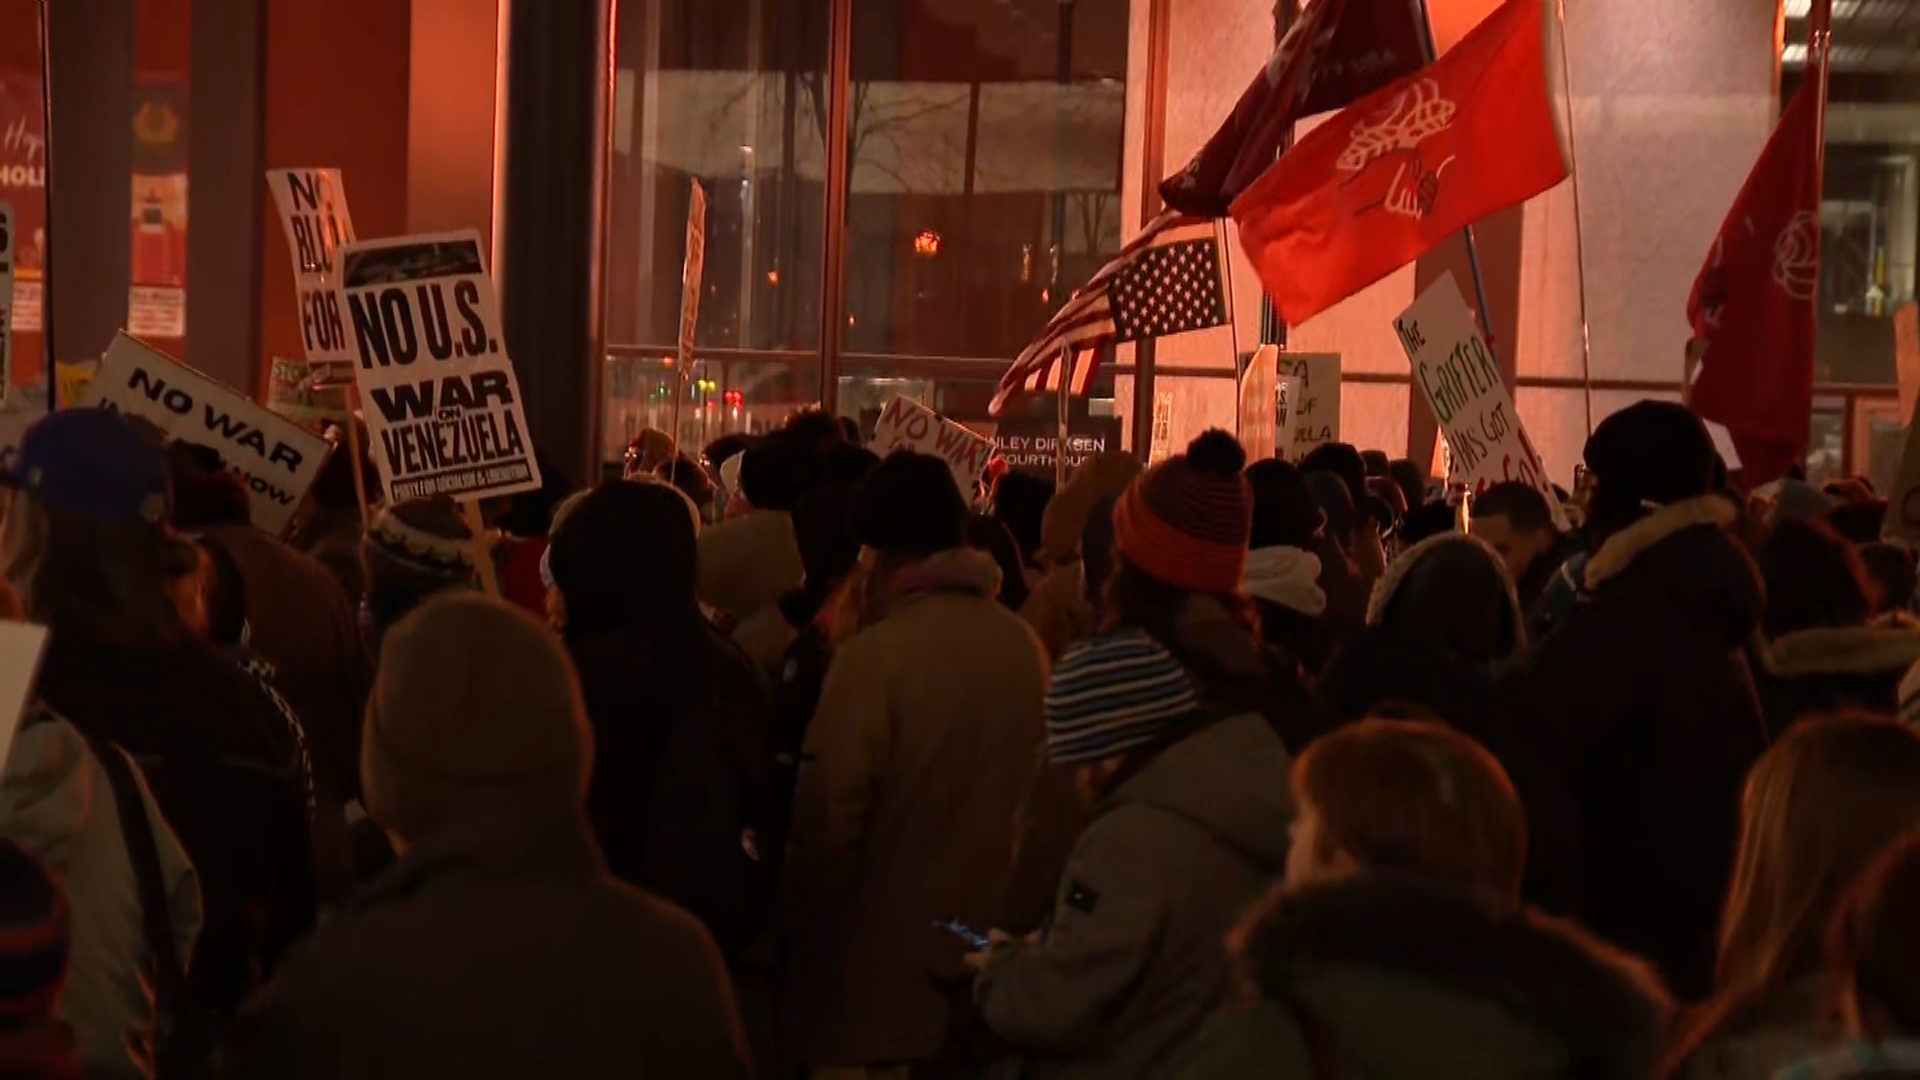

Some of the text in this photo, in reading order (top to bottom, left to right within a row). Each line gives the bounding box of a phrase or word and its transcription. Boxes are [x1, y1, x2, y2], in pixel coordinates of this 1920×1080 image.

[301, 289, 346, 351] FOR
[348, 279, 499, 369] NO U.S.
[1398, 319, 1425, 355] THE
[370, 370, 514, 423] WAR
[1419, 335, 1499, 424] GRIFTER
[127, 368, 193, 415] NO
[204, 404, 303, 473] WAR
[380, 409, 525, 476] VENEZUELA
[437, 407, 461, 424] ON
[883, 399, 929, 440] NO
